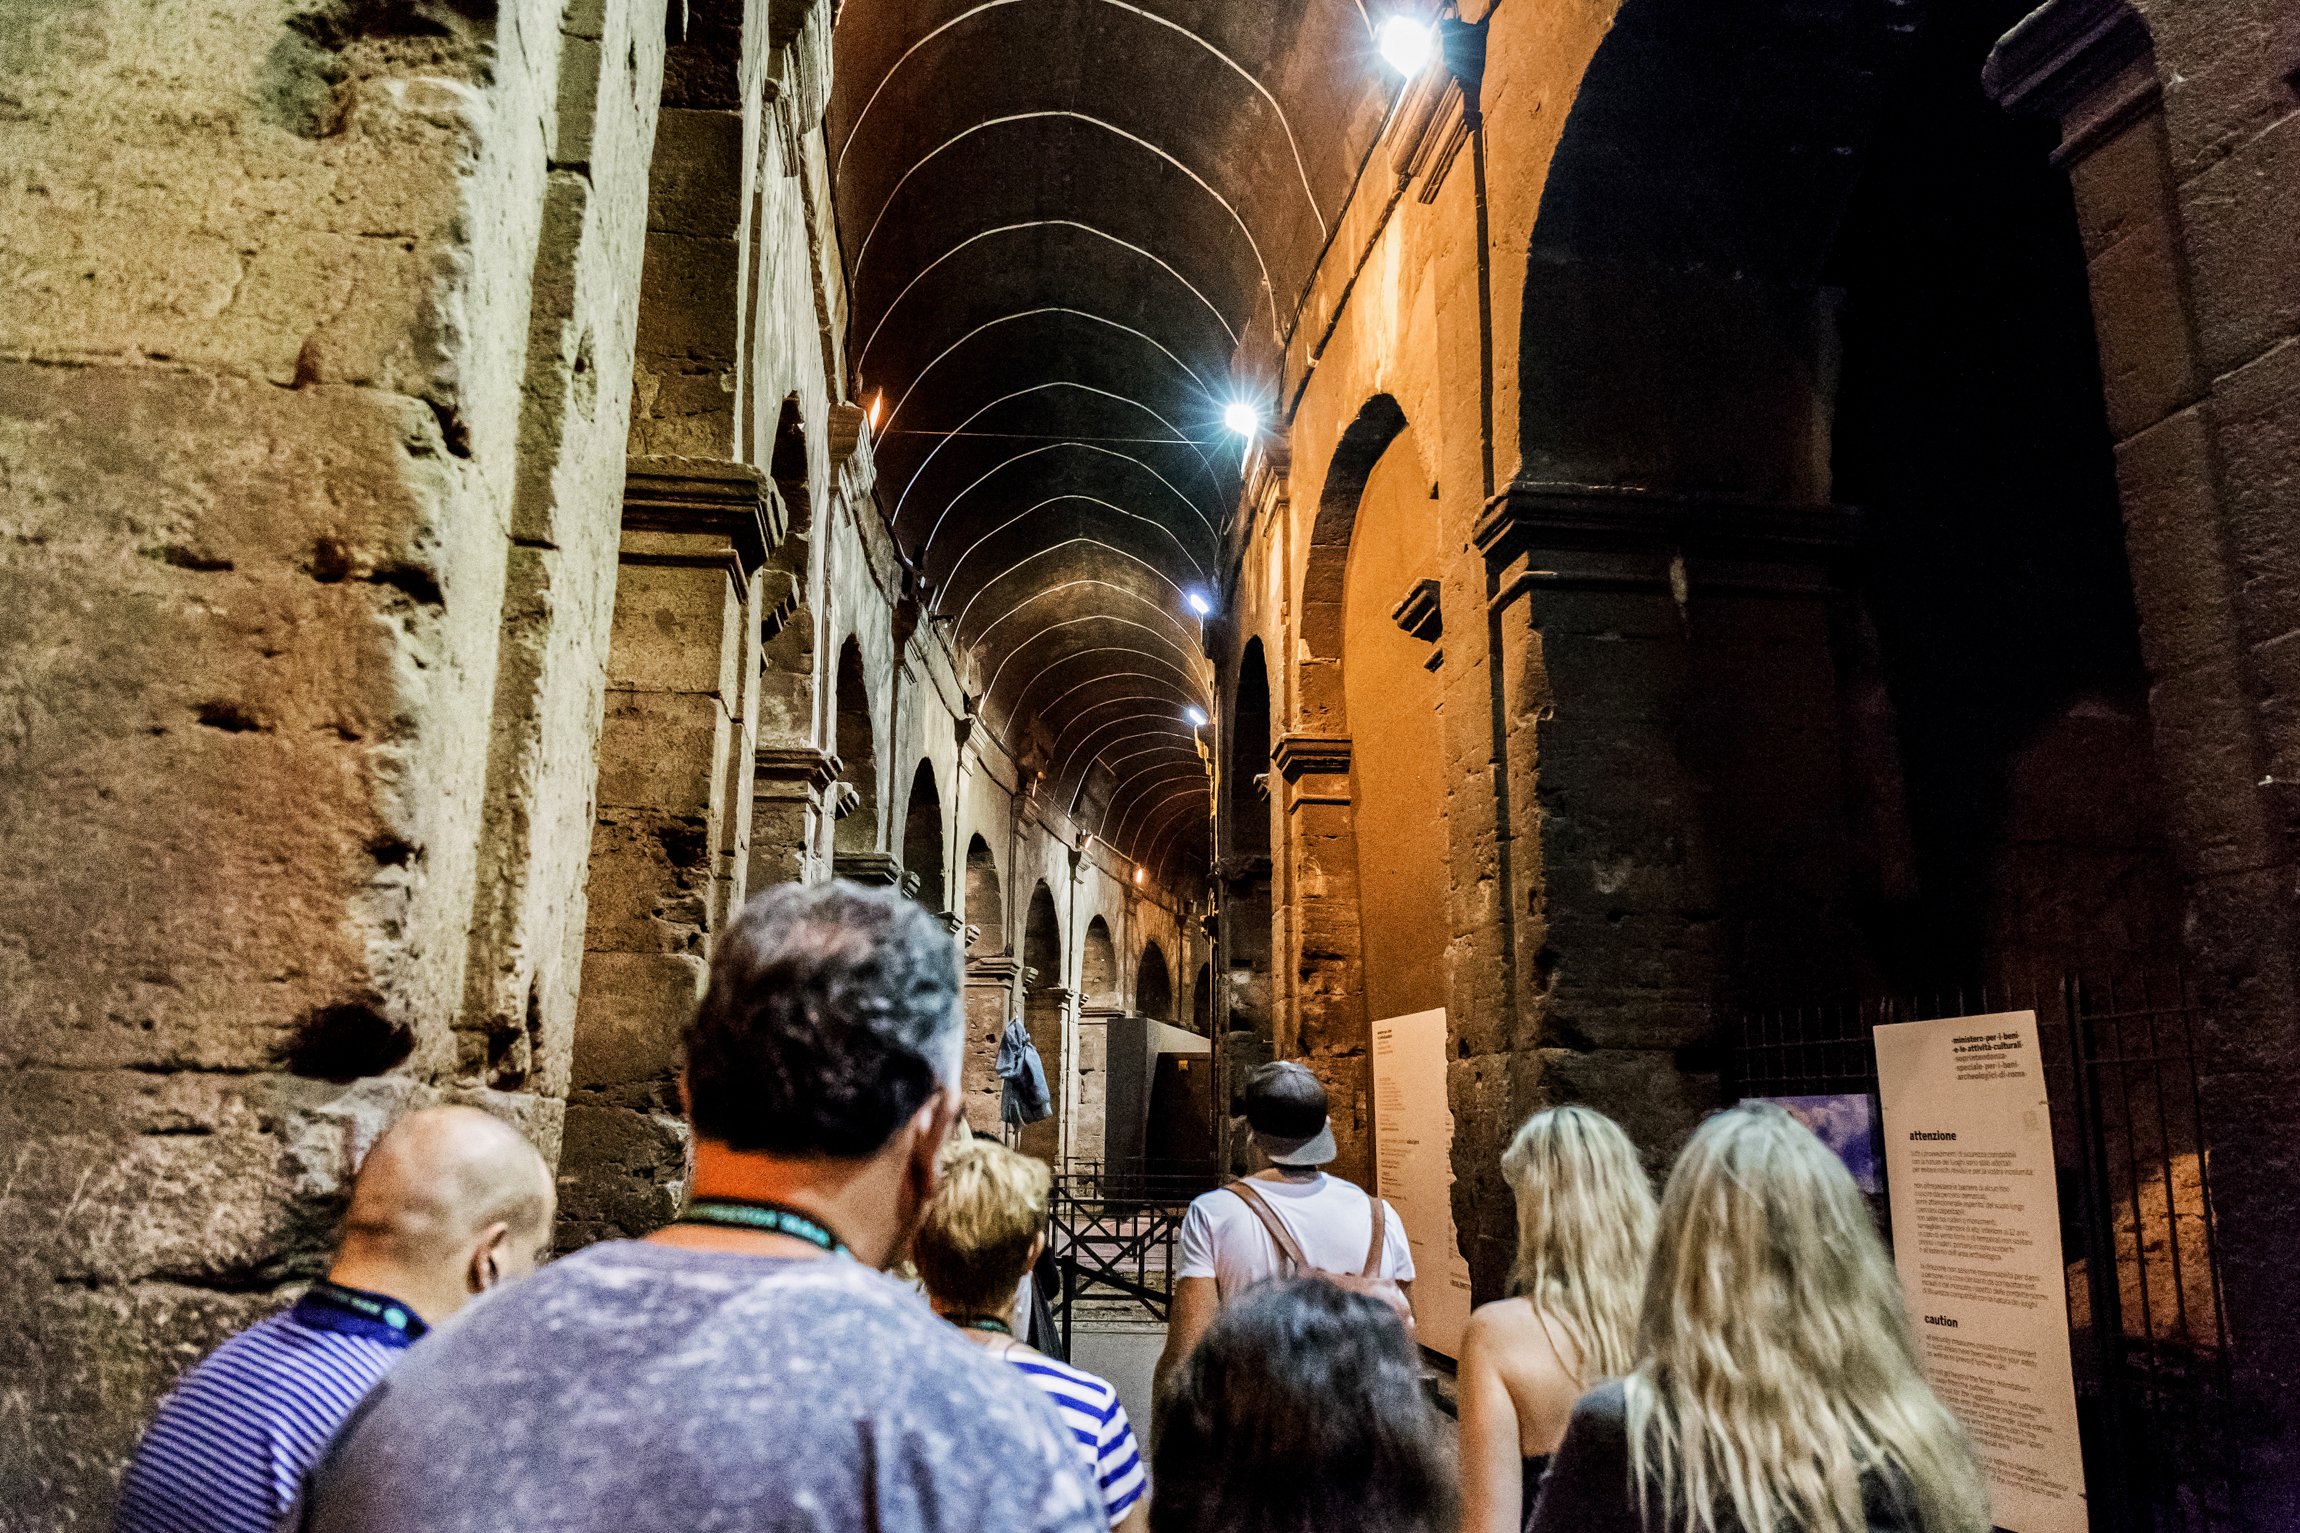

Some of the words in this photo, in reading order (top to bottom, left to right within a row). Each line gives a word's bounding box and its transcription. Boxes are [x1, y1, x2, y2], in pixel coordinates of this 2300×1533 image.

[1952, 1036, 1984, 1044] ministero
[1986, 1034, 1996, 1042] per
[2003, 1031, 2019, 1040] beni
[1993, 1041, 2022, 1050] culturali
[1909, 1130, 1957, 1141] attenzione
[1924, 1314, 1958, 1328] caution
